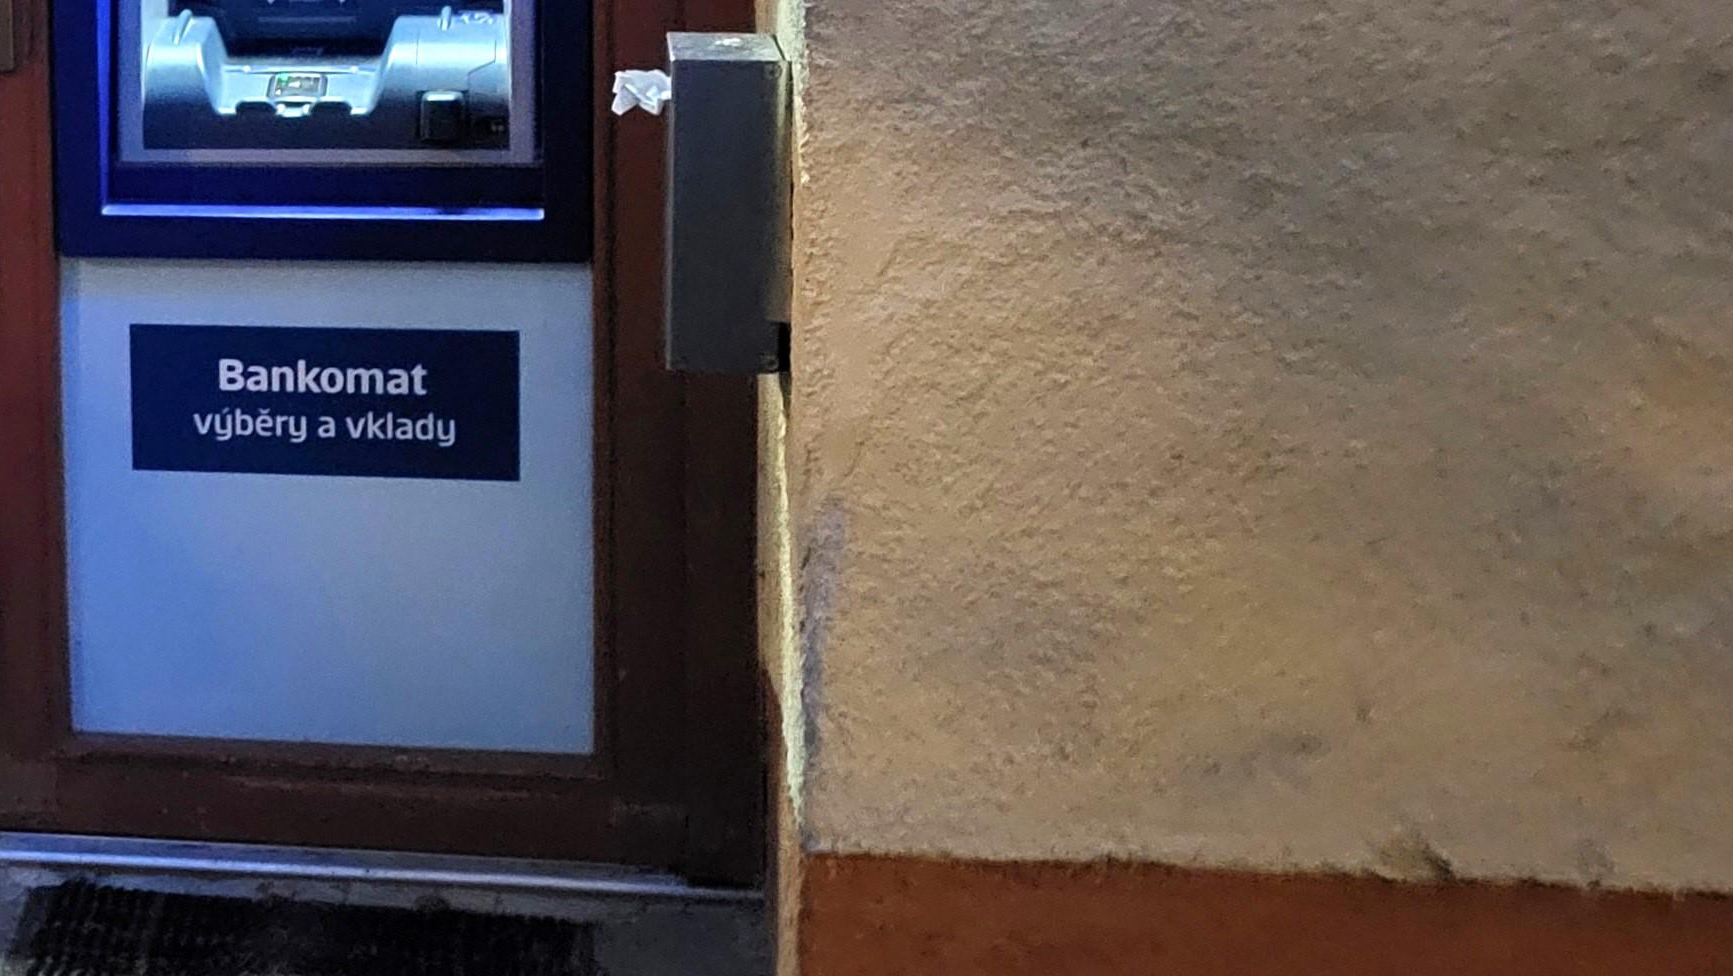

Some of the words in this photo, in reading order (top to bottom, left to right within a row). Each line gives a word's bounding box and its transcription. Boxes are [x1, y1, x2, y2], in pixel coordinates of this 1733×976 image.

[218, 358, 427, 395] Bankomat
[193, 407, 307, 443] výběry
[317, 416, 336, 438] a
[346, 411, 456, 447] vklady
